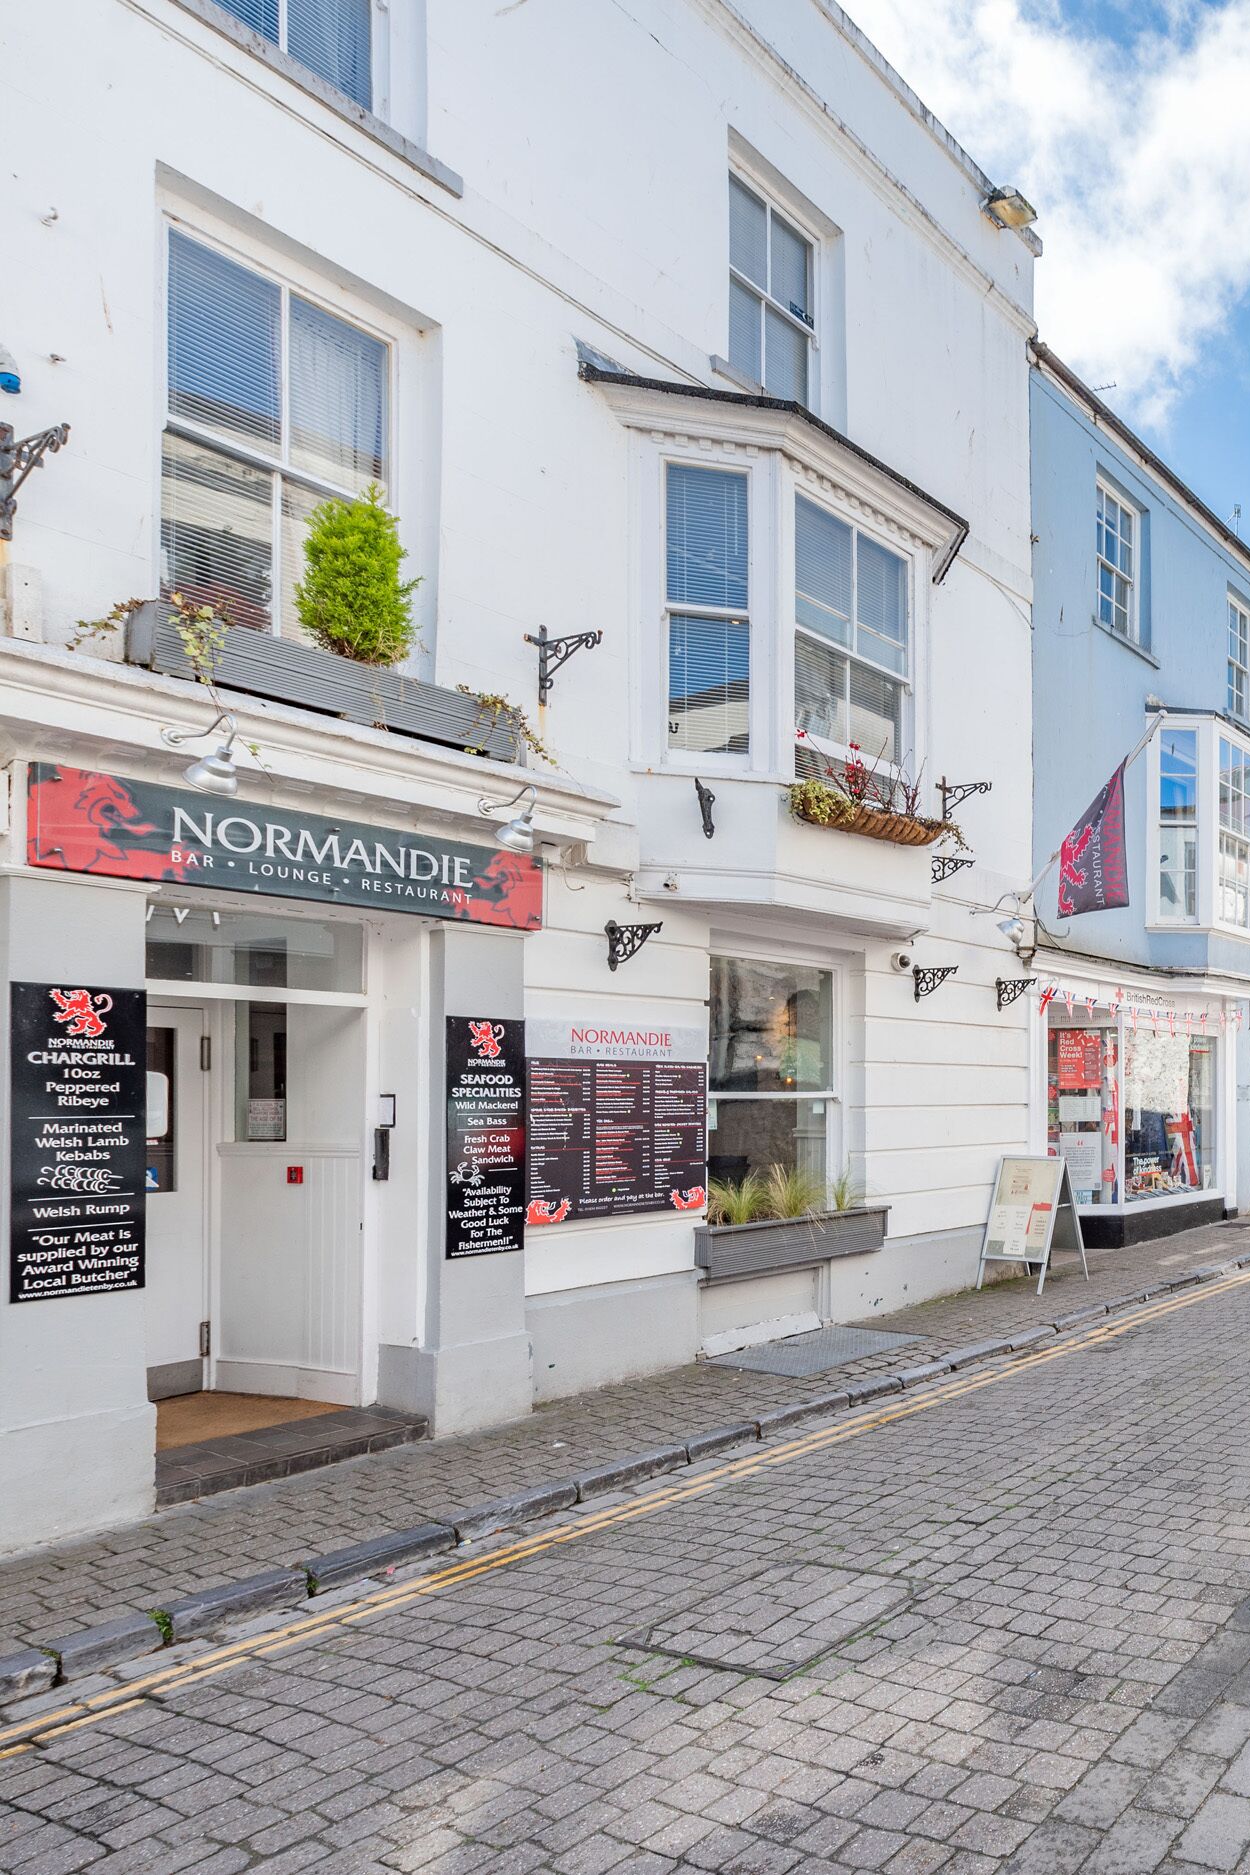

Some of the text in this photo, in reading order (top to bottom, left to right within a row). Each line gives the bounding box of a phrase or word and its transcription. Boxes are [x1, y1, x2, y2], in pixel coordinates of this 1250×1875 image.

[1103, 774, 1125, 904] RMANDIE
[172, 807, 473, 888] NORMANDIE
[172, 851, 473, 904] BAR LOUNGE RESTAURANT
[48, 1038, 114, 1047] NORMANDIE
[571, 1028, 672, 1046] NORMANDIE
[570, 1046, 672, 1056] BAR RESTAURANT
[27, 1051, 136, 1066] CHARGRILL
[63, 1068, 101, 1079] 10oz
[460, 1074, 513, 1085] SEAFOOD
[46, 1082, 120, 1094] Peppered
[452, 1087, 522, 1098] SPECIALITIES
[58, 1095, 109, 1108] Ribeye
[455, 1101, 518, 1110] Wild Mackerel
[468, 1117, 507, 1125] Sea Bass
[43, 1122, 122, 1134] Marinated
[35, 1136, 129, 1148] Welsh Lamb
[464, 1134, 510, 1143] Fresh Crab
[56, 1150, 110, 1161] Kebabs
[463, 1145, 511, 1154] Claw Meat
[472, 1155, 514, 1164] Sandwich
[463, 1196, 510, 1207] Subject To
[32, 1204, 130, 1218] Welsh Rump
[448, 1206, 523, 1219] Weather & Some
[461, 1216, 509, 1229] Good Luck
[74, 1231, 115, 1243] Meat
[119, 1230, 131, 1239] is
[470, 1228, 503, 1238] For The
[17, 1243, 139, 1263] supplied by our
[22, 1256, 139, 1276] Award Winning
[23, 1275, 66, 1290] Local
[18, 1280, 138, 1299] www.normandietenby.co.uk
